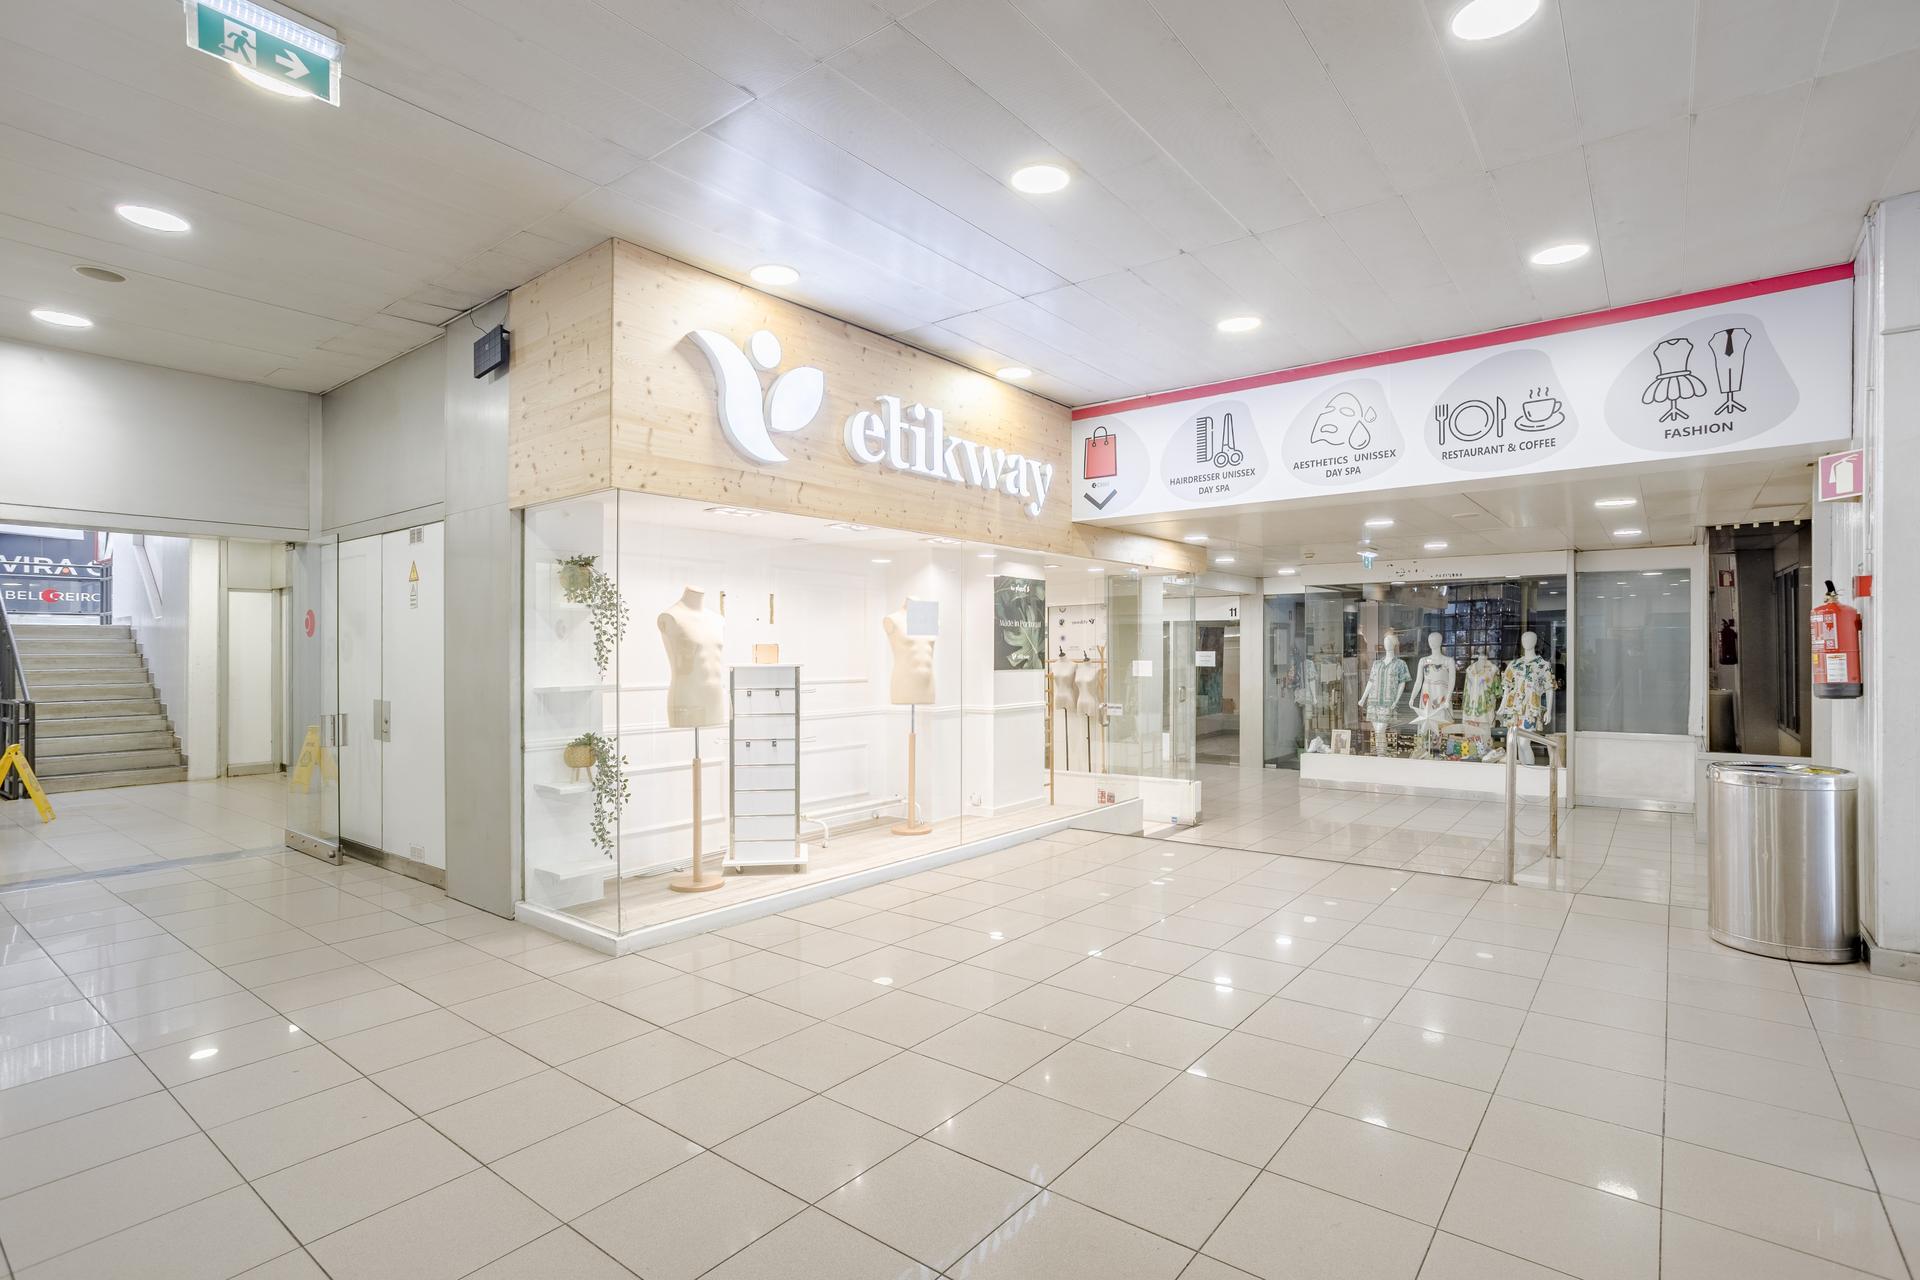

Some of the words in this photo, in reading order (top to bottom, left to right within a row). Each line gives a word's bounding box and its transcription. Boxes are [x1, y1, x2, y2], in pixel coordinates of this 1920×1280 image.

[1664, 421, 1733, 440] FASHION
[843, 394, 1053, 517] etikway
[1441, 444, 1505, 460] RESTAURANT
[1507, 443, 1516, 452] &
[1519, 437, 1556, 451] COFFEE
[1293, 455, 1348, 470] AESTHETICS
[1354, 448, 1397, 462] UNISSEX
[1169, 471, 1221, 486] HAIRDRESSER
[1222, 467, 1256, 480] UNISSEX
[1325, 468, 1343, 478] DAY
[1345, 466, 1361, 476] SPA
[1198, 485, 1213, 495] DAY
[1215, 484, 1230, 493] SPA
[1229, 607, 1237, 617] 11
